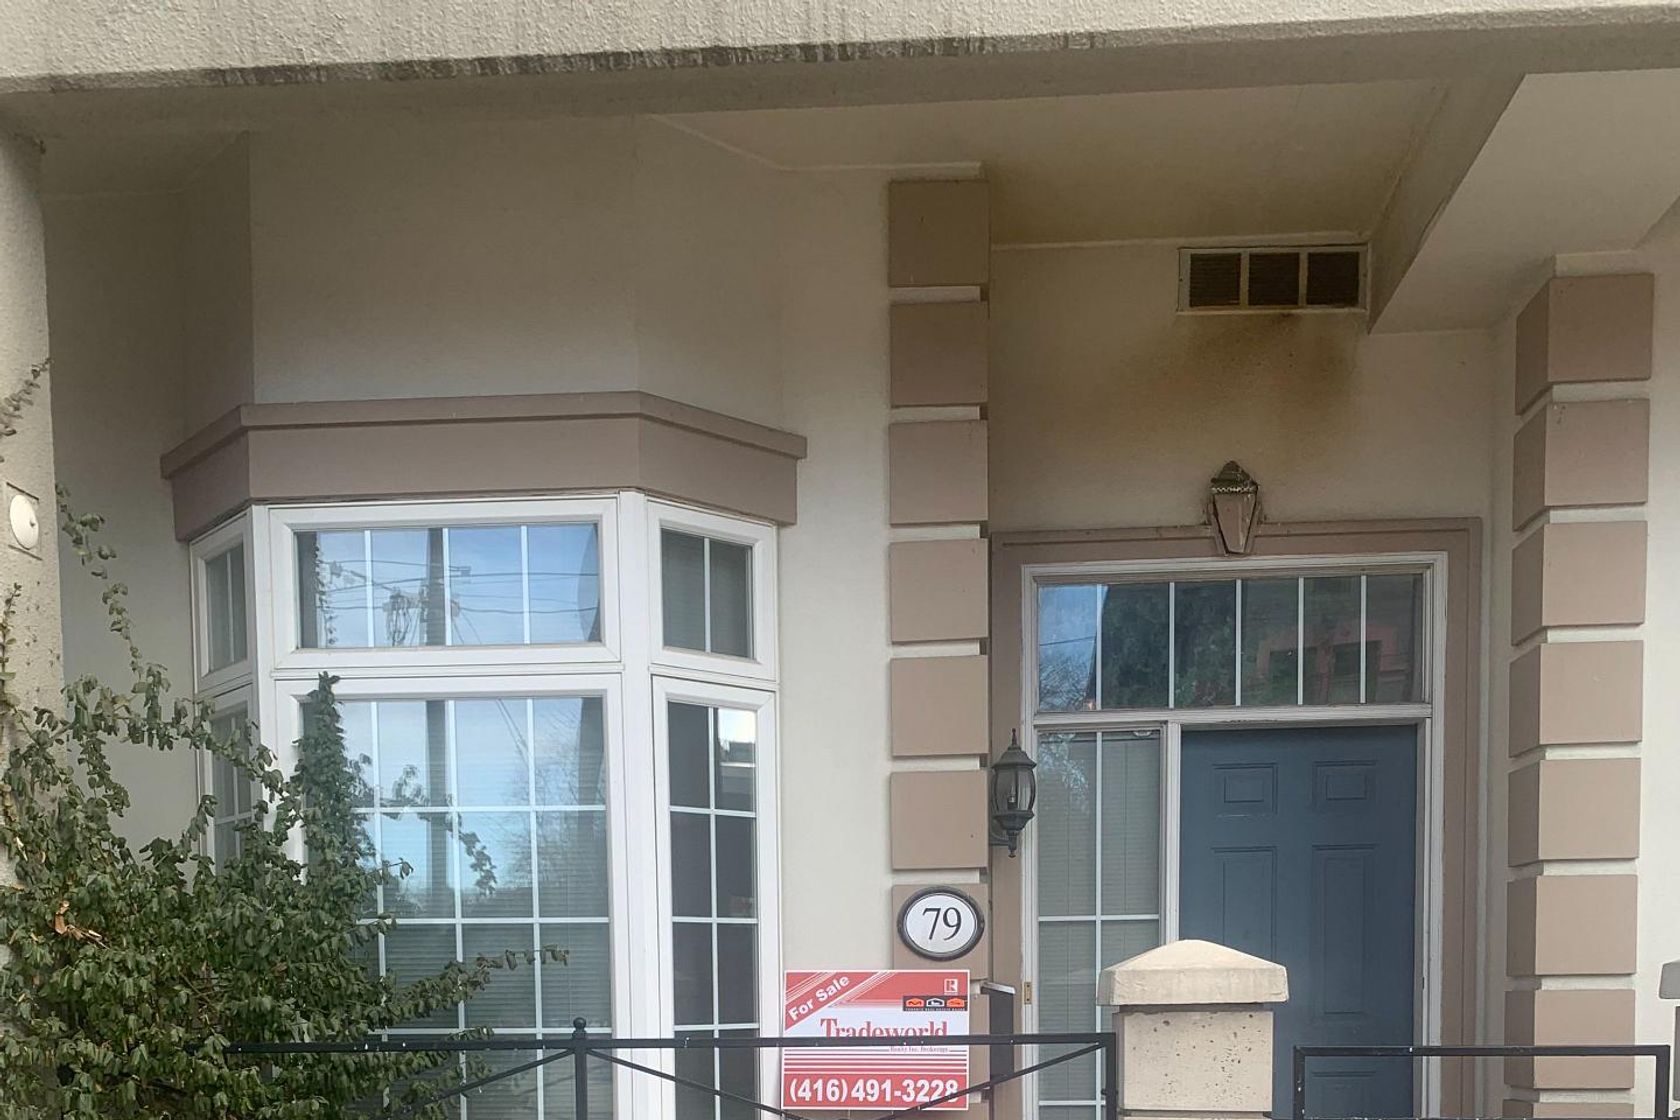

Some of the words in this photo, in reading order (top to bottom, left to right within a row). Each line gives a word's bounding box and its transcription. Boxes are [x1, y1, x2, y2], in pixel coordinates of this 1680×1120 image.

[922, 907, 962, 941] 79
[788, 998, 813, 1021] For
[815, 976, 850, 1002] Sale
[820, 1018, 947, 1038] Tradeworld
